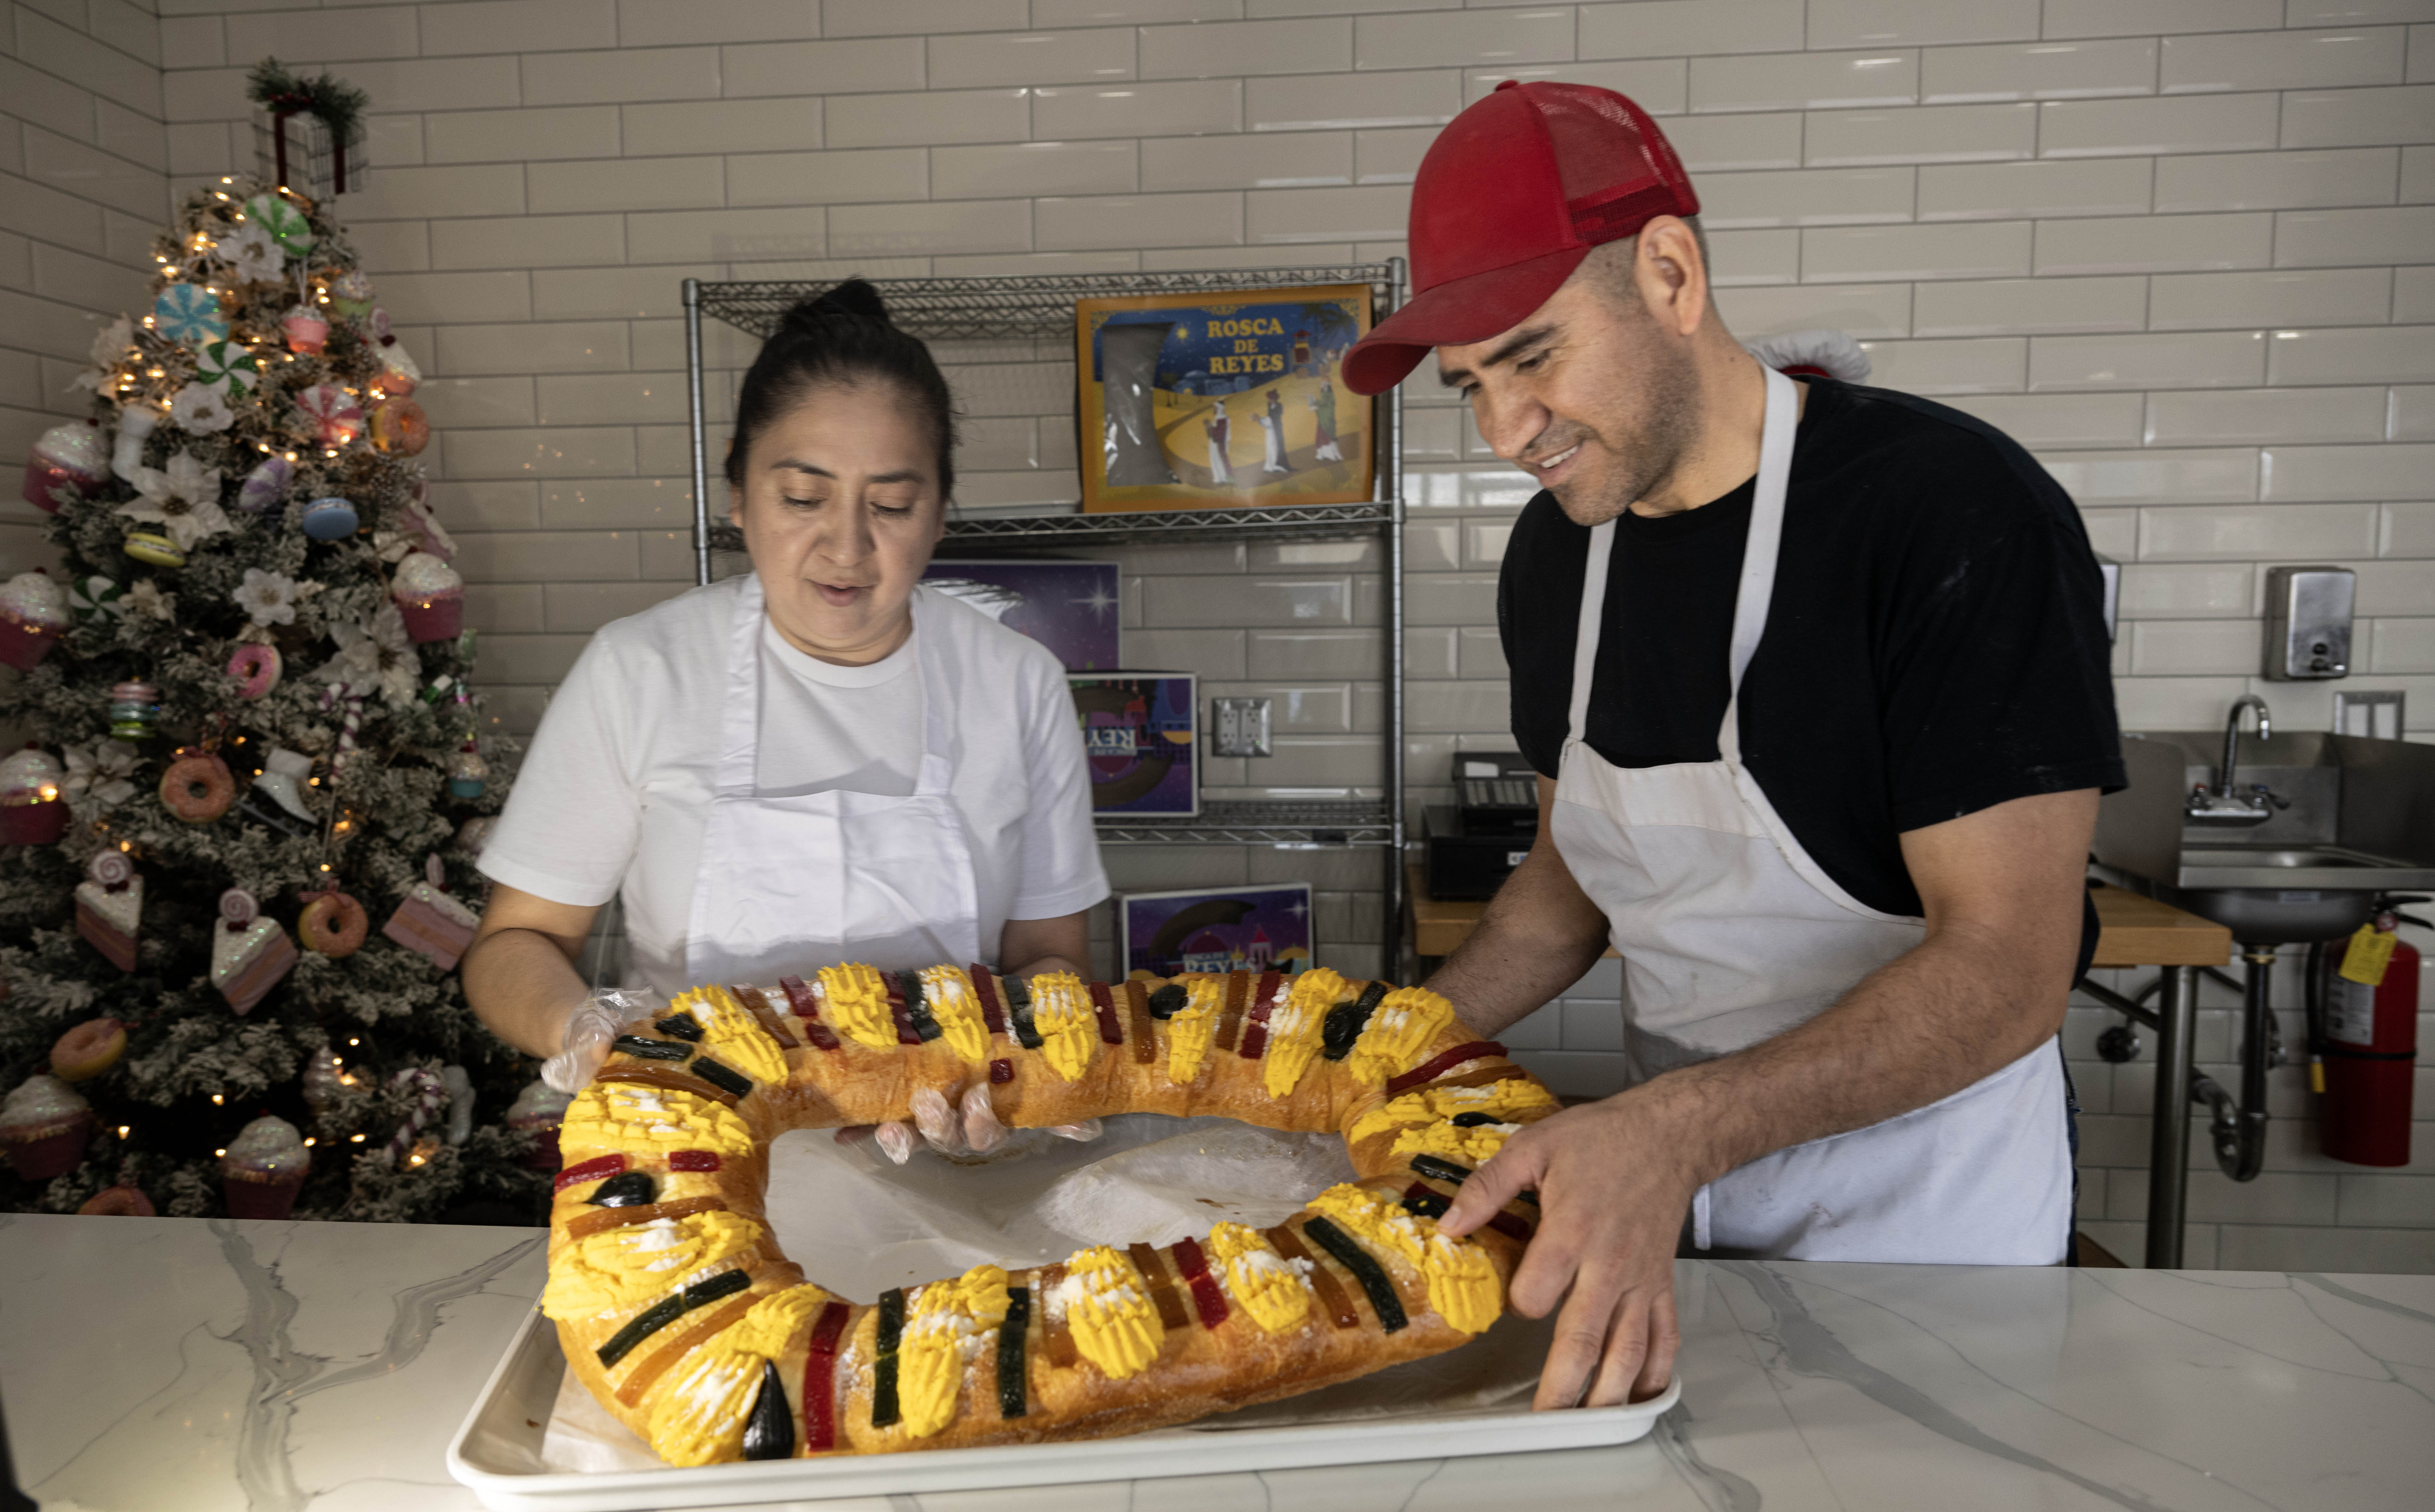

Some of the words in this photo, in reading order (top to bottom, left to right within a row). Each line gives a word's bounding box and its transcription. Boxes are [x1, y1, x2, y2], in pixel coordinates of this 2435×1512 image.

[1207, 317, 1284, 337] ROSCA
[1234, 338, 1258, 353] DE
[1209, 353, 1284, 374] REYES
[1087, 729, 1136, 748] REY
